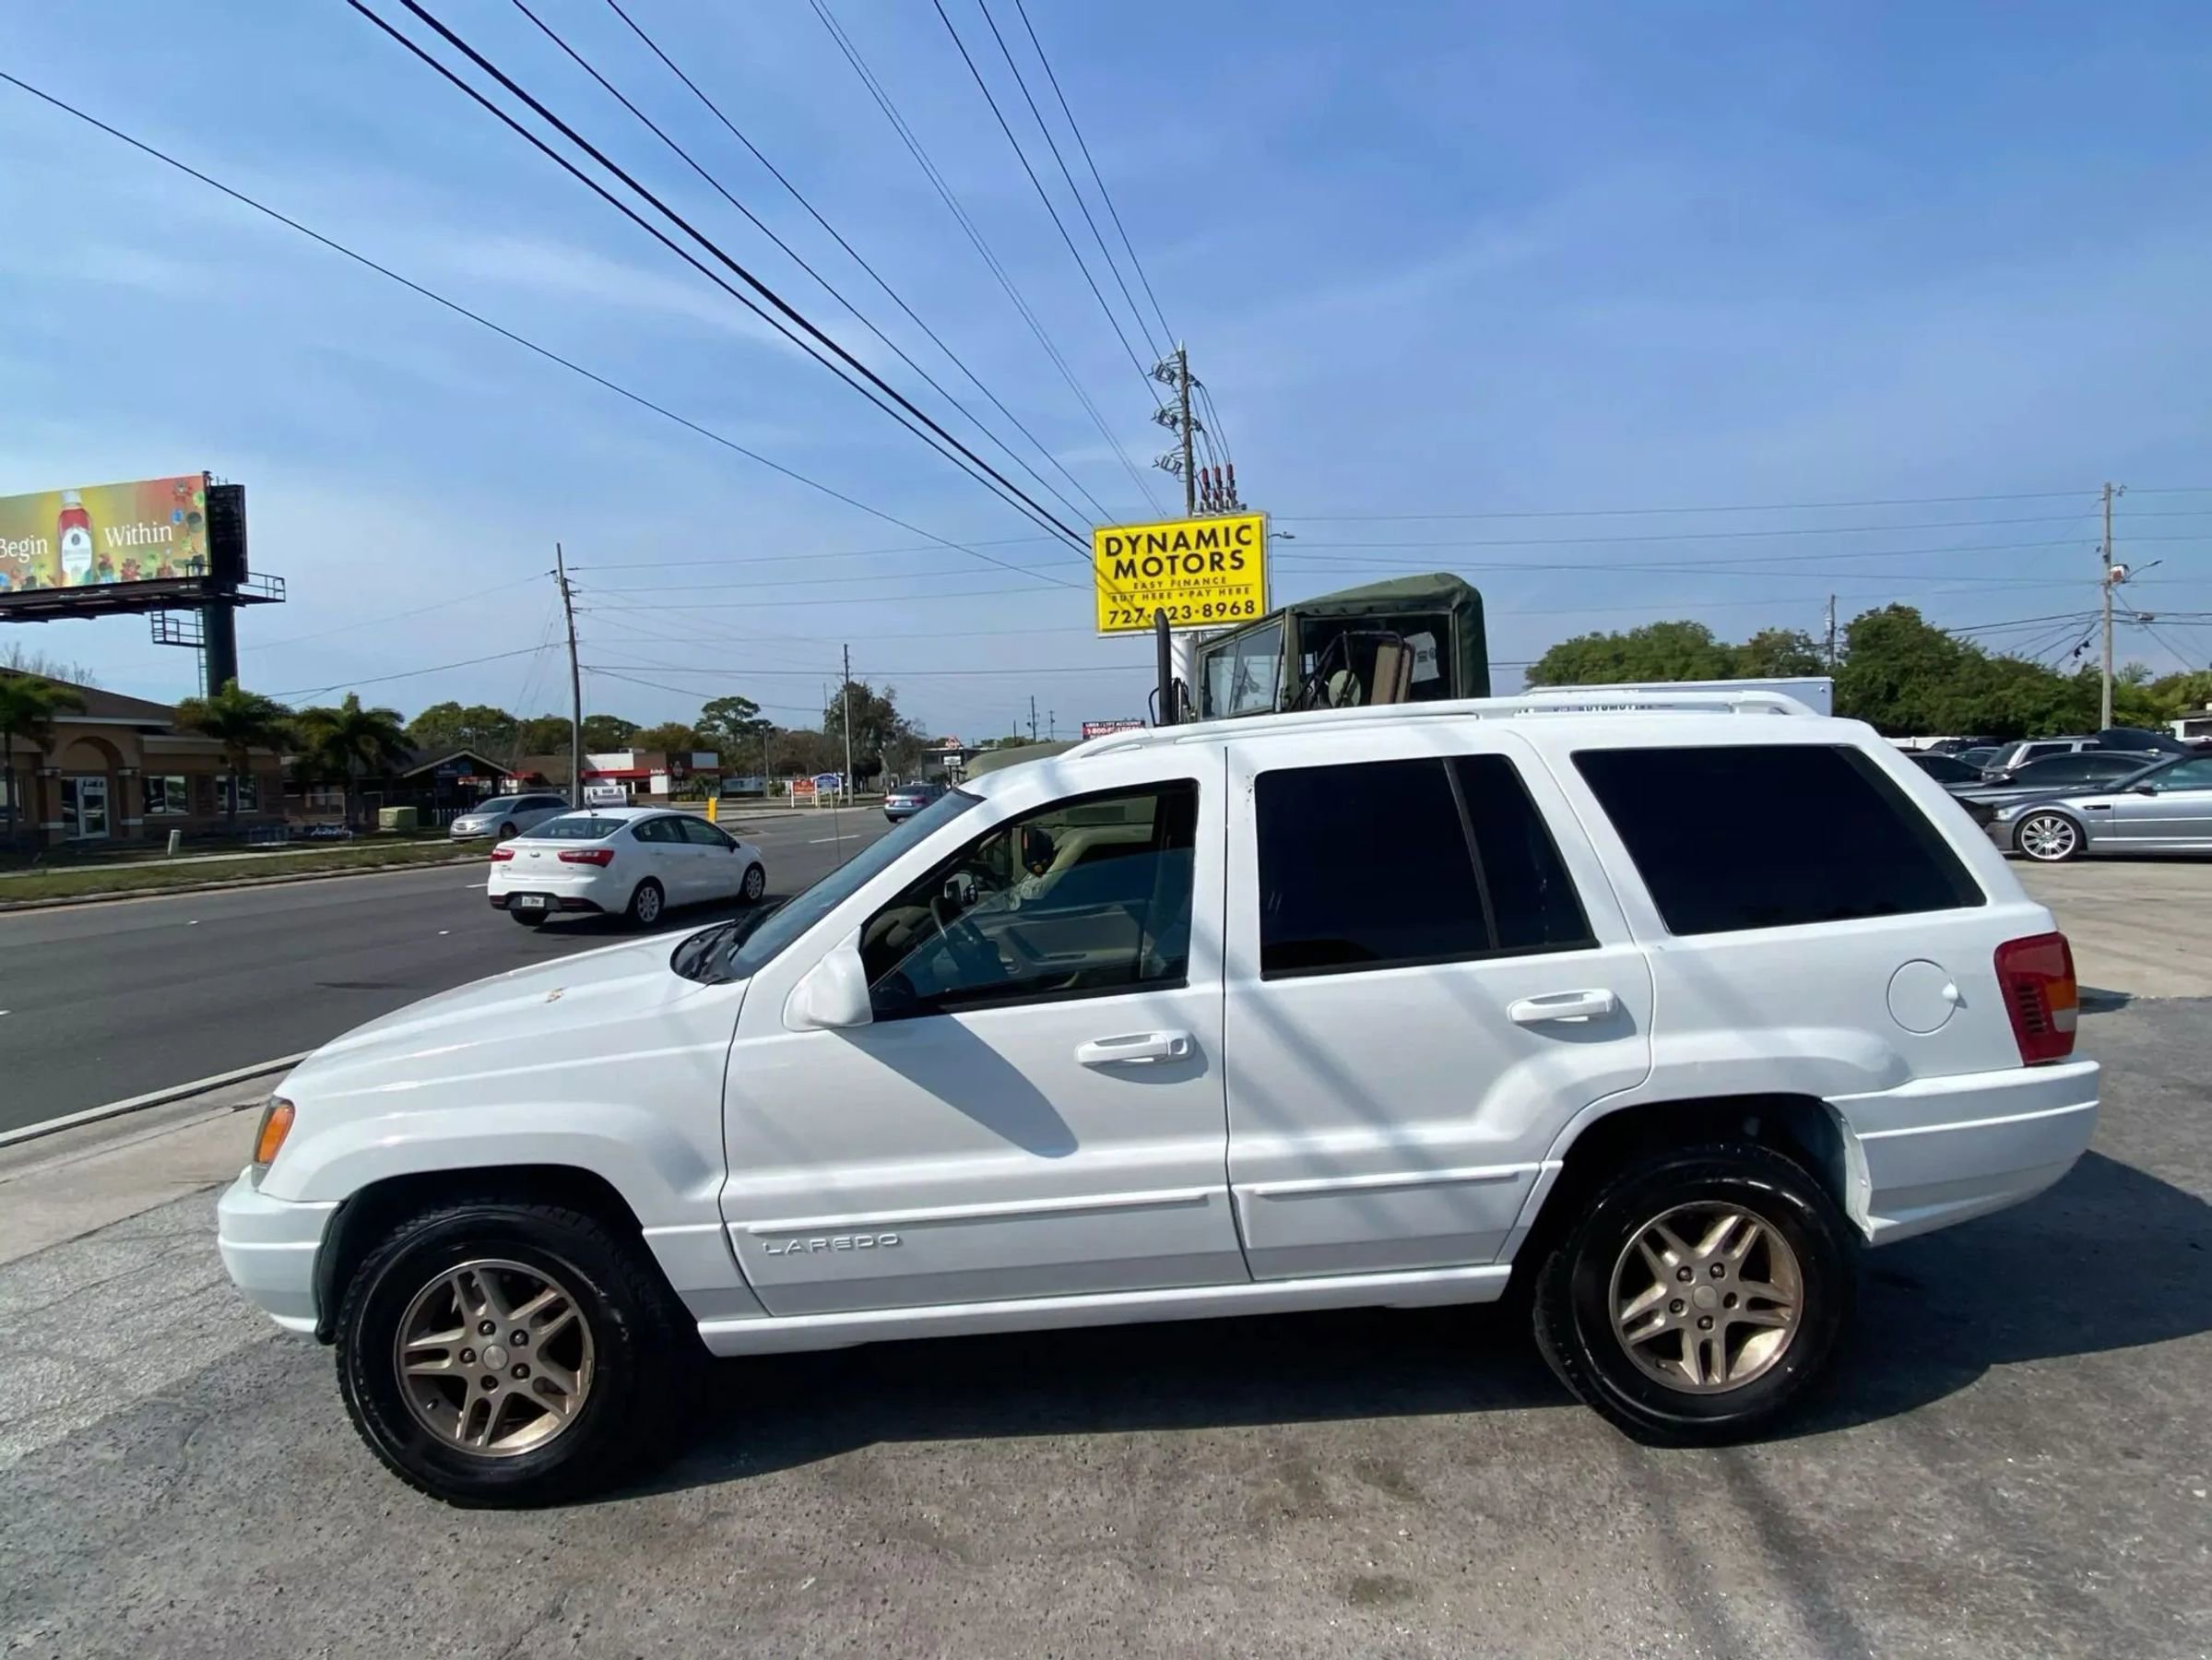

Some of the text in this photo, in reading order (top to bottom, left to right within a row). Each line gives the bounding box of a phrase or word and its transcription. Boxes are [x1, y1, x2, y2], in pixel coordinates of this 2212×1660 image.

[0, 535, 48, 563] Begin
[103, 521, 173, 547] Within
[1105, 525, 1252, 557] DYNAMIC
[1113, 549, 1245, 579] MOTORS
[1111, 587, 1249, 603] BUY HERE PAY HERE
[1133, 575, 1227, 590] EASY FINANCE
[1108, 599, 1255, 624] 727·23·8968
[762, 1233, 899, 1255] LAREDO
